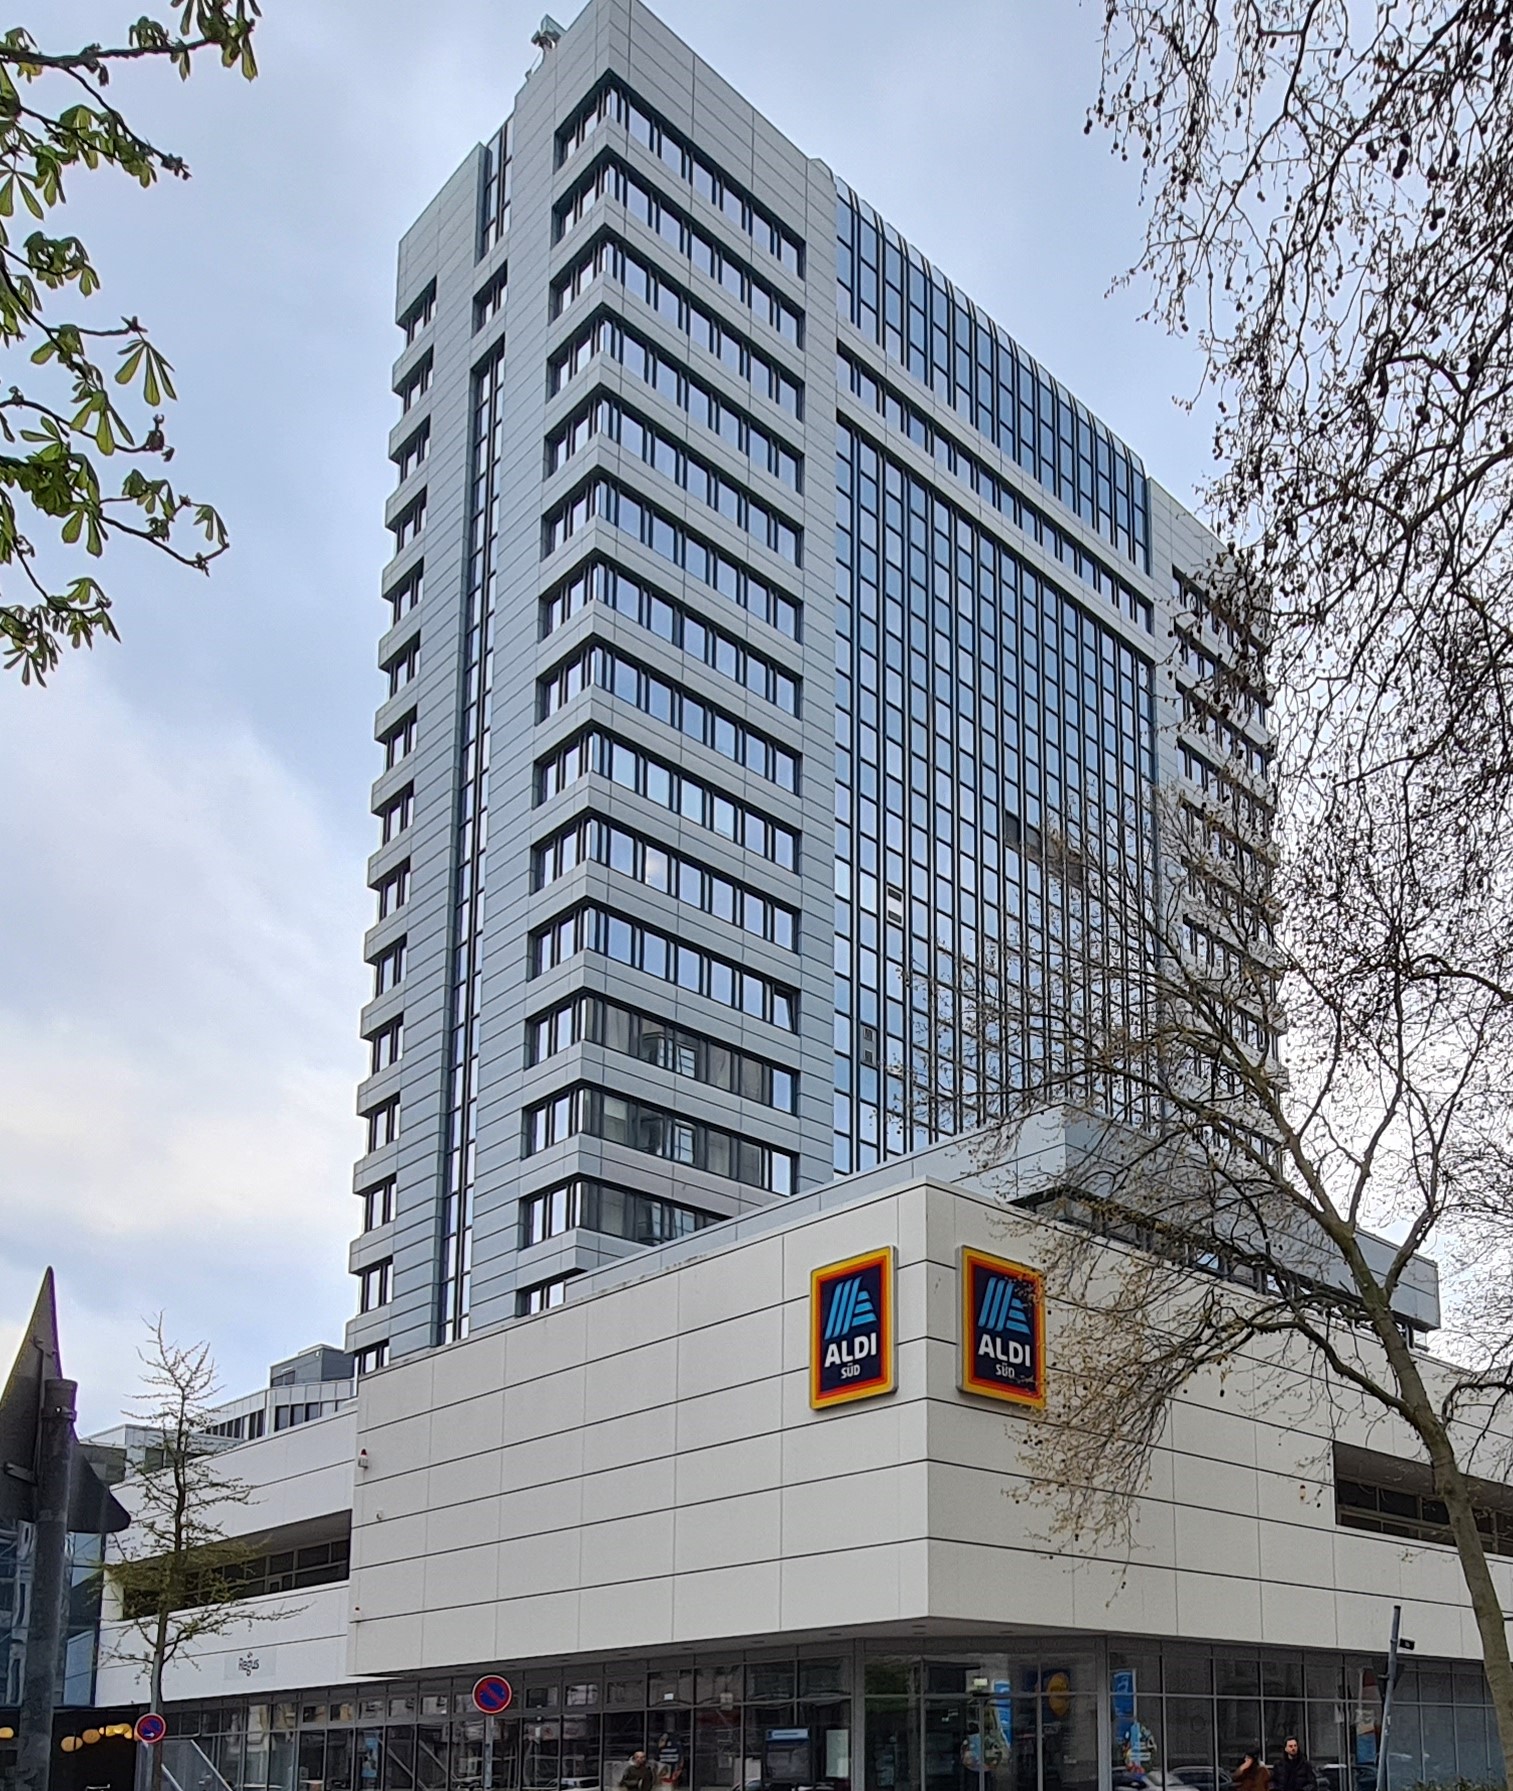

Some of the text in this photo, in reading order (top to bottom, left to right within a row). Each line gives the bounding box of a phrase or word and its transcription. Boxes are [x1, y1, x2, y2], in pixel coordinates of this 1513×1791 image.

[824, 1332, 877, 1368] ALDI
[977, 1333, 1031, 1367] ALDI
[840, 1362, 861, 1379] SÜD
[995, 1362, 1015, 1379] SÜD
[238, 1657, 260, 1677] Regus
